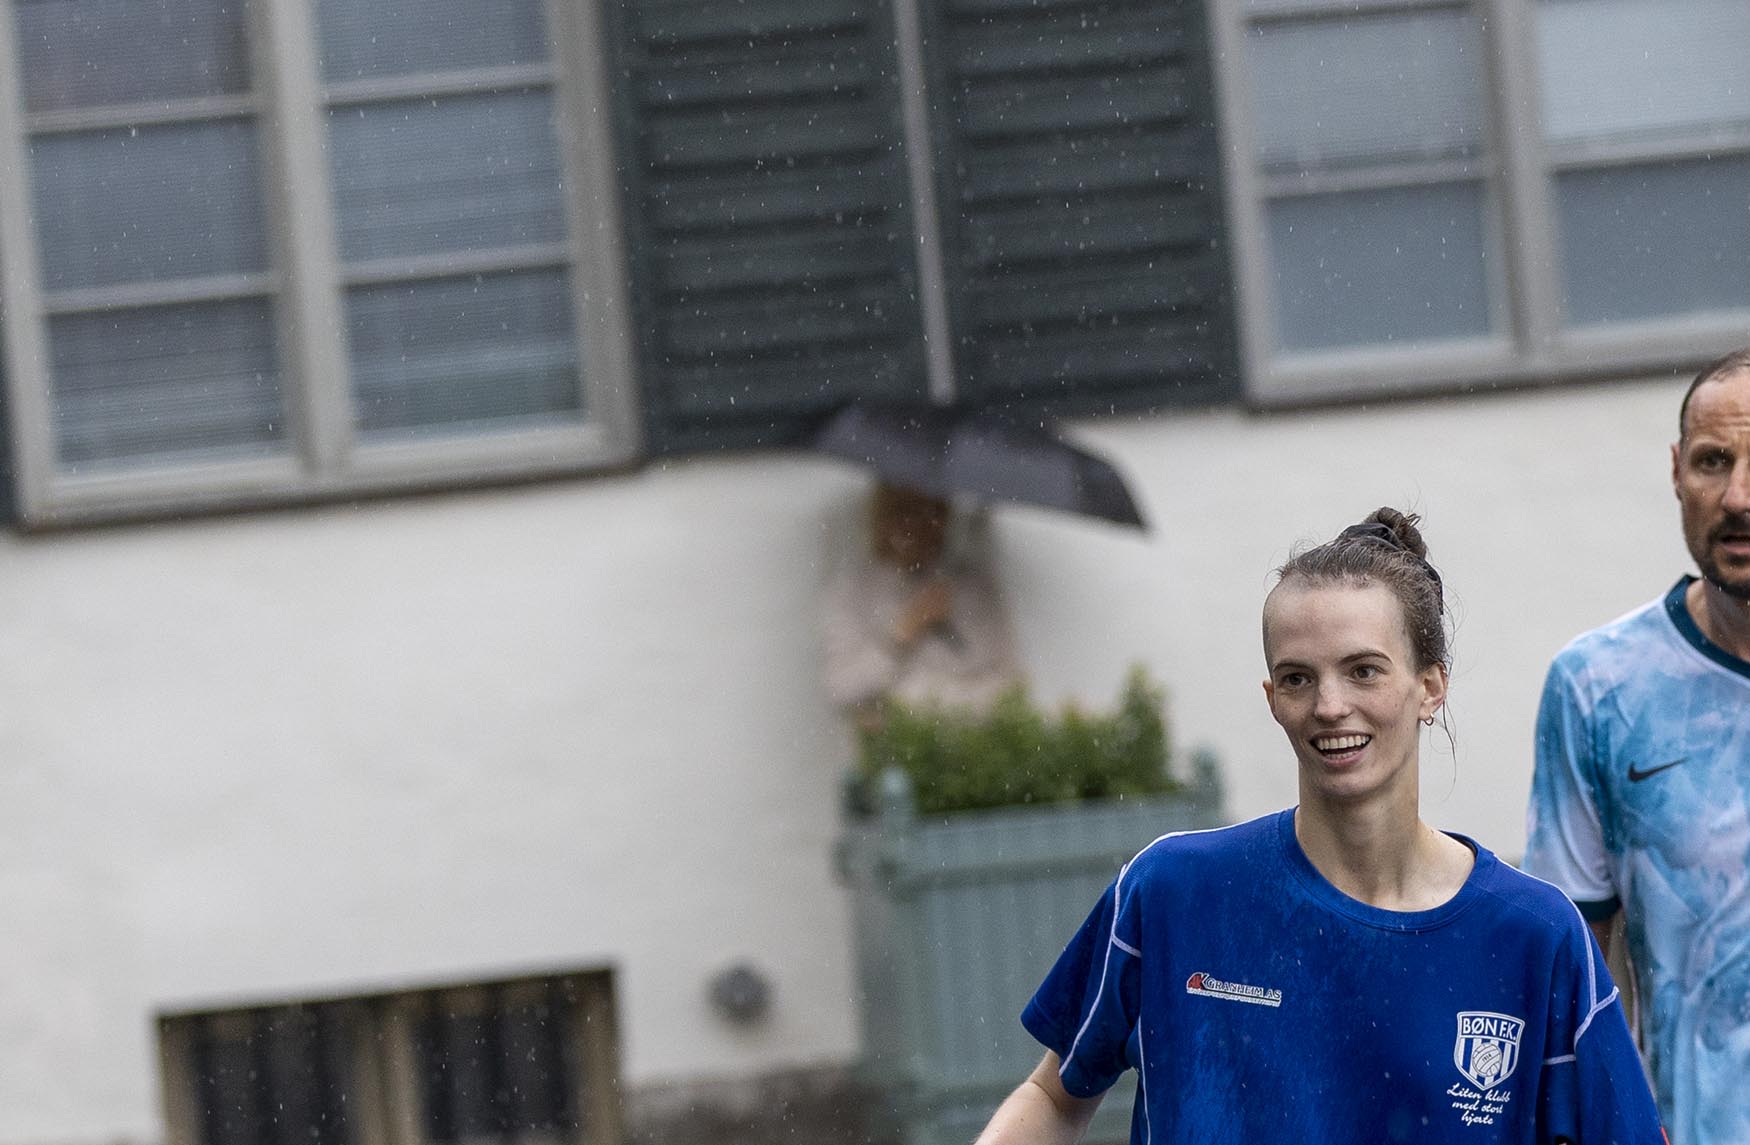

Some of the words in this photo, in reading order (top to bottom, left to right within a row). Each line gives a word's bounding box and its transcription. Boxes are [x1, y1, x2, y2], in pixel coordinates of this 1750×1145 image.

[1206, 978, 1264, 997] GRANHEIM
[1265, 988, 1282, 999] AS
[1462, 1017, 1498, 1036] BØN
[1446, 1082, 1482, 1099] Liten
[1485, 1089, 1511, 1103] klubb
[1452, 1099, 1480, 1111] med
[1461, 1110, 1494, 1126] hjerte
